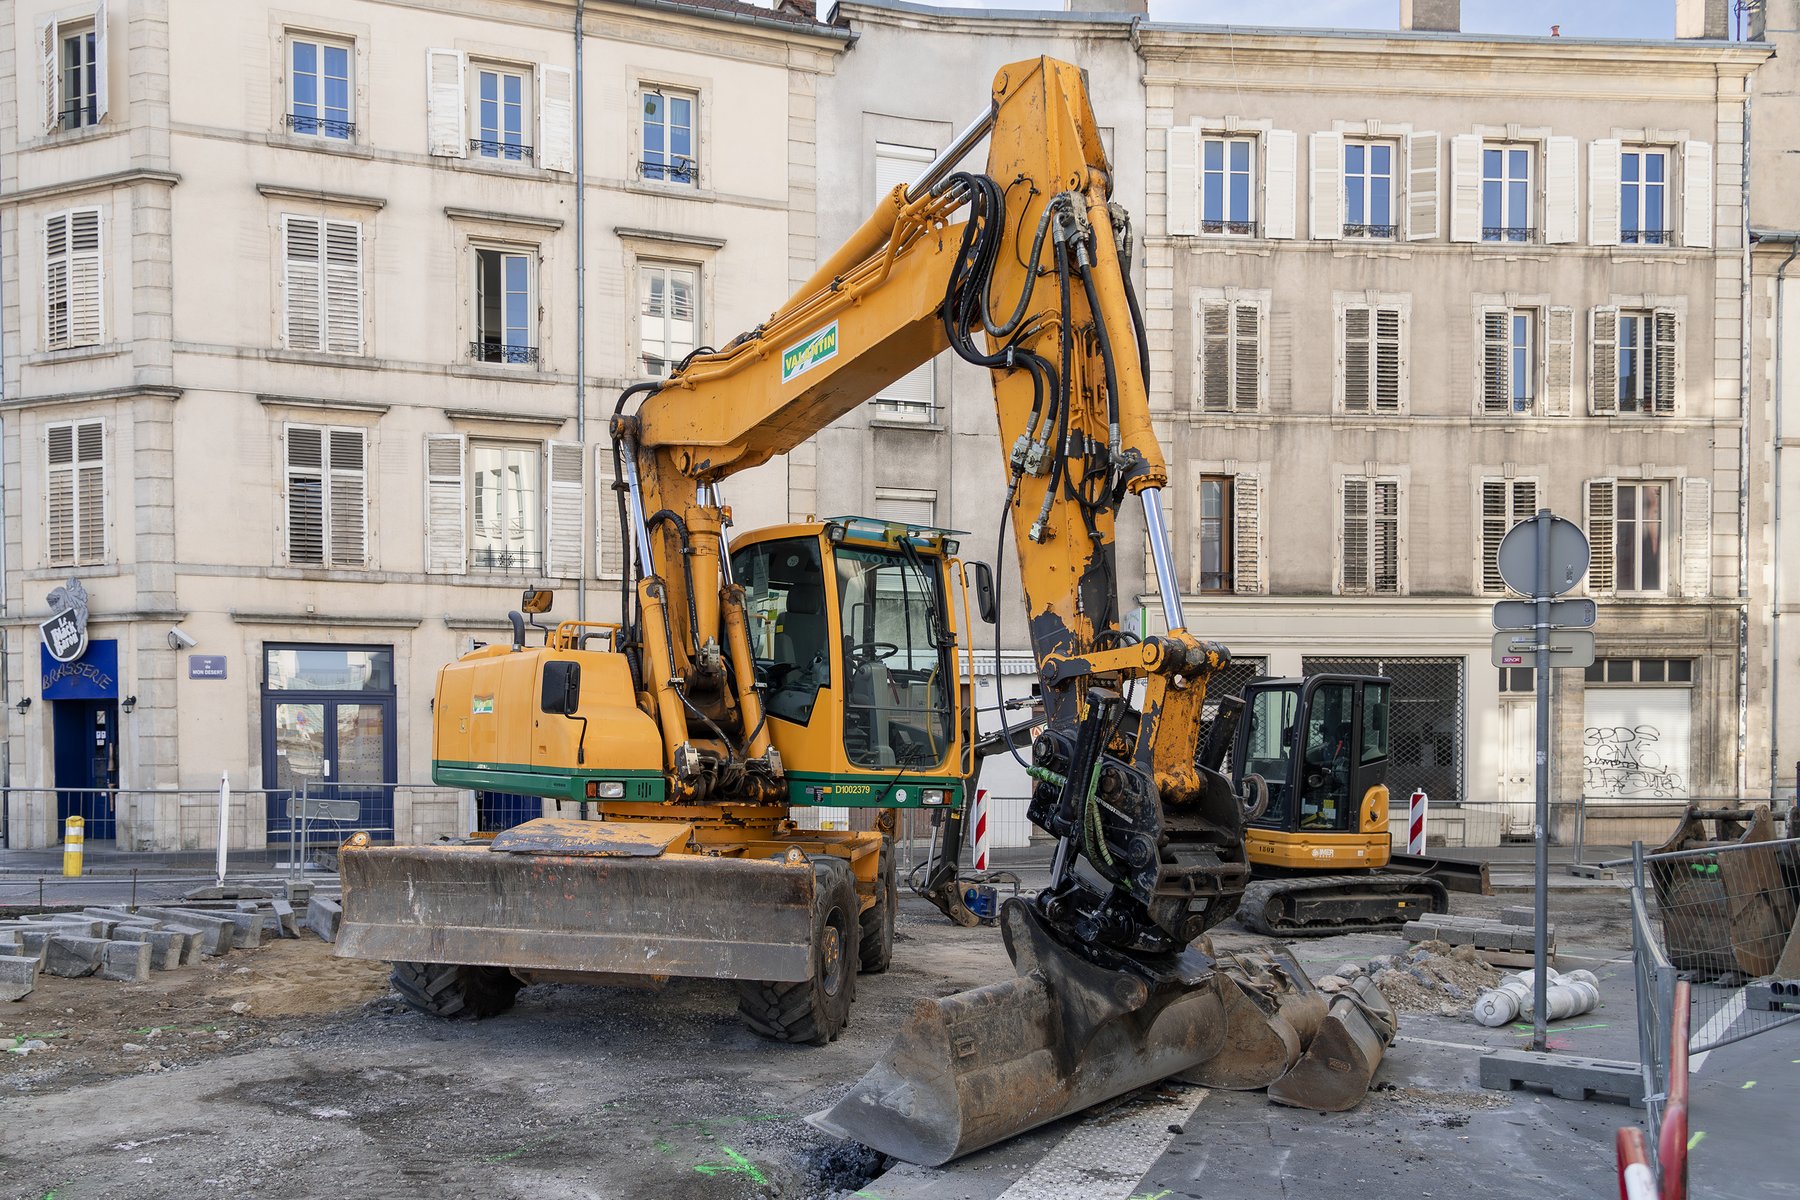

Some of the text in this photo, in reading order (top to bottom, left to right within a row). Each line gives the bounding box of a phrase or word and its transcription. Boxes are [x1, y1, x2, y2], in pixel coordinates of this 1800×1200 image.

[50, 621, 77, 642] Black
[43, 662, 113, 690] BRASSERIE
[835, 785, 871, 794] D1002379
